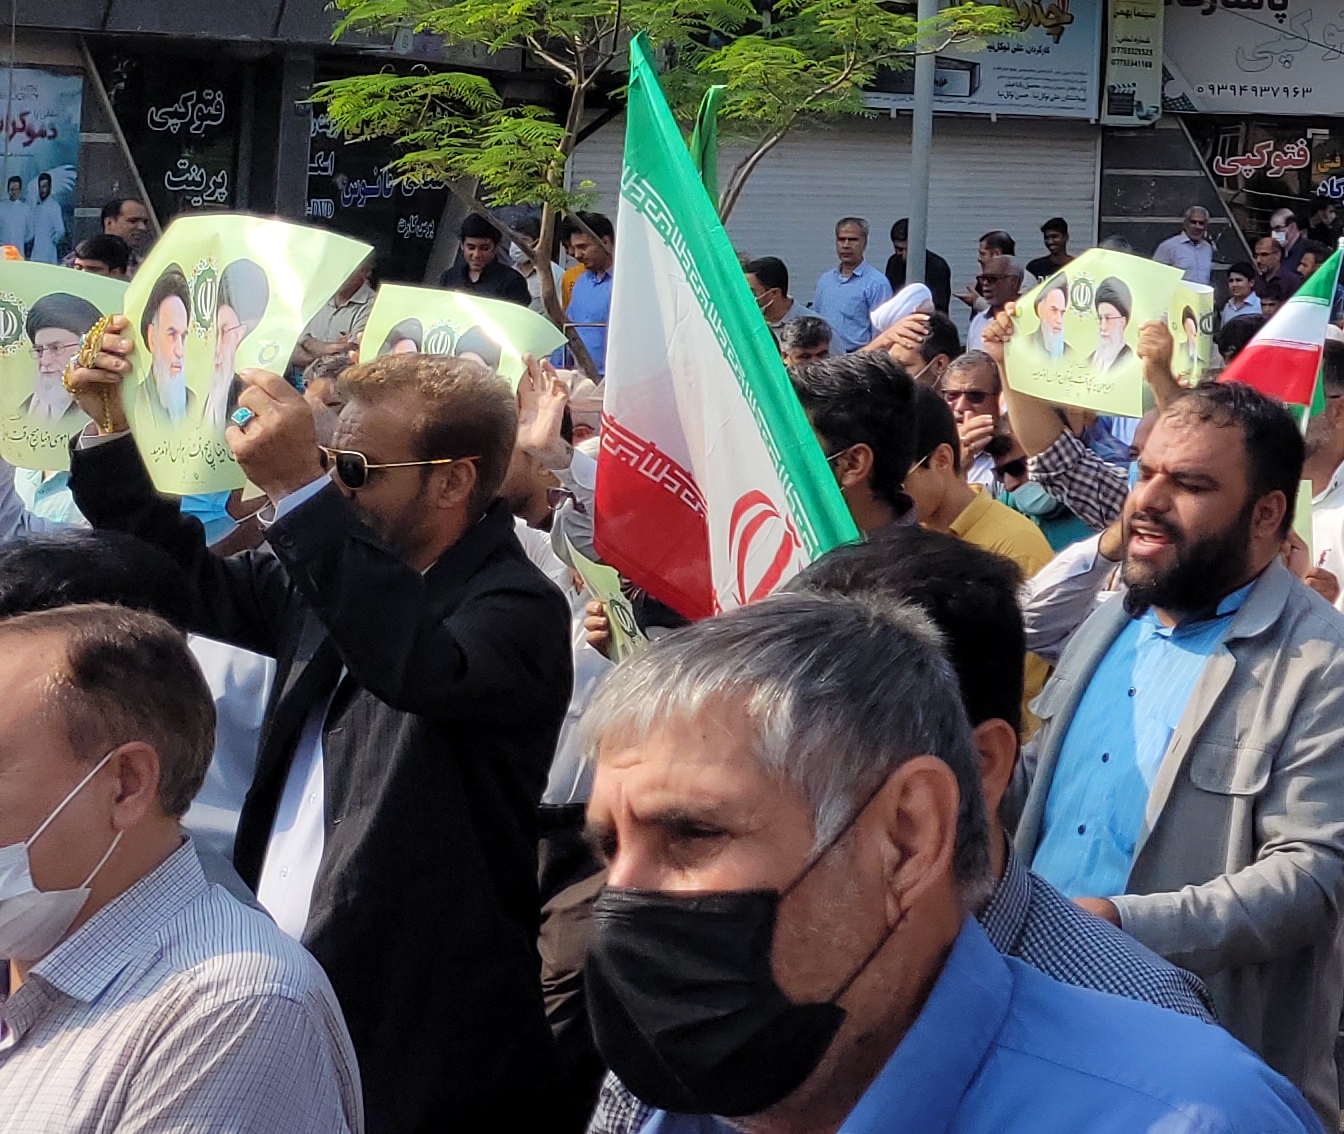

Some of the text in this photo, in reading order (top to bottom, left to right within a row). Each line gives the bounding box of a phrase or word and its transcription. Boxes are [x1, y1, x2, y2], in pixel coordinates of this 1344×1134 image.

[1197, 84, 1314, 99] ۰۹۳۹۴۹۳۷۹۶۳
[147, 90, 226, 134] فتوکپی
[308, 151, 335, 176] اسک
[1315, 152, 1342, 173] فنی
[164, 159, 228, 207] پرینت
